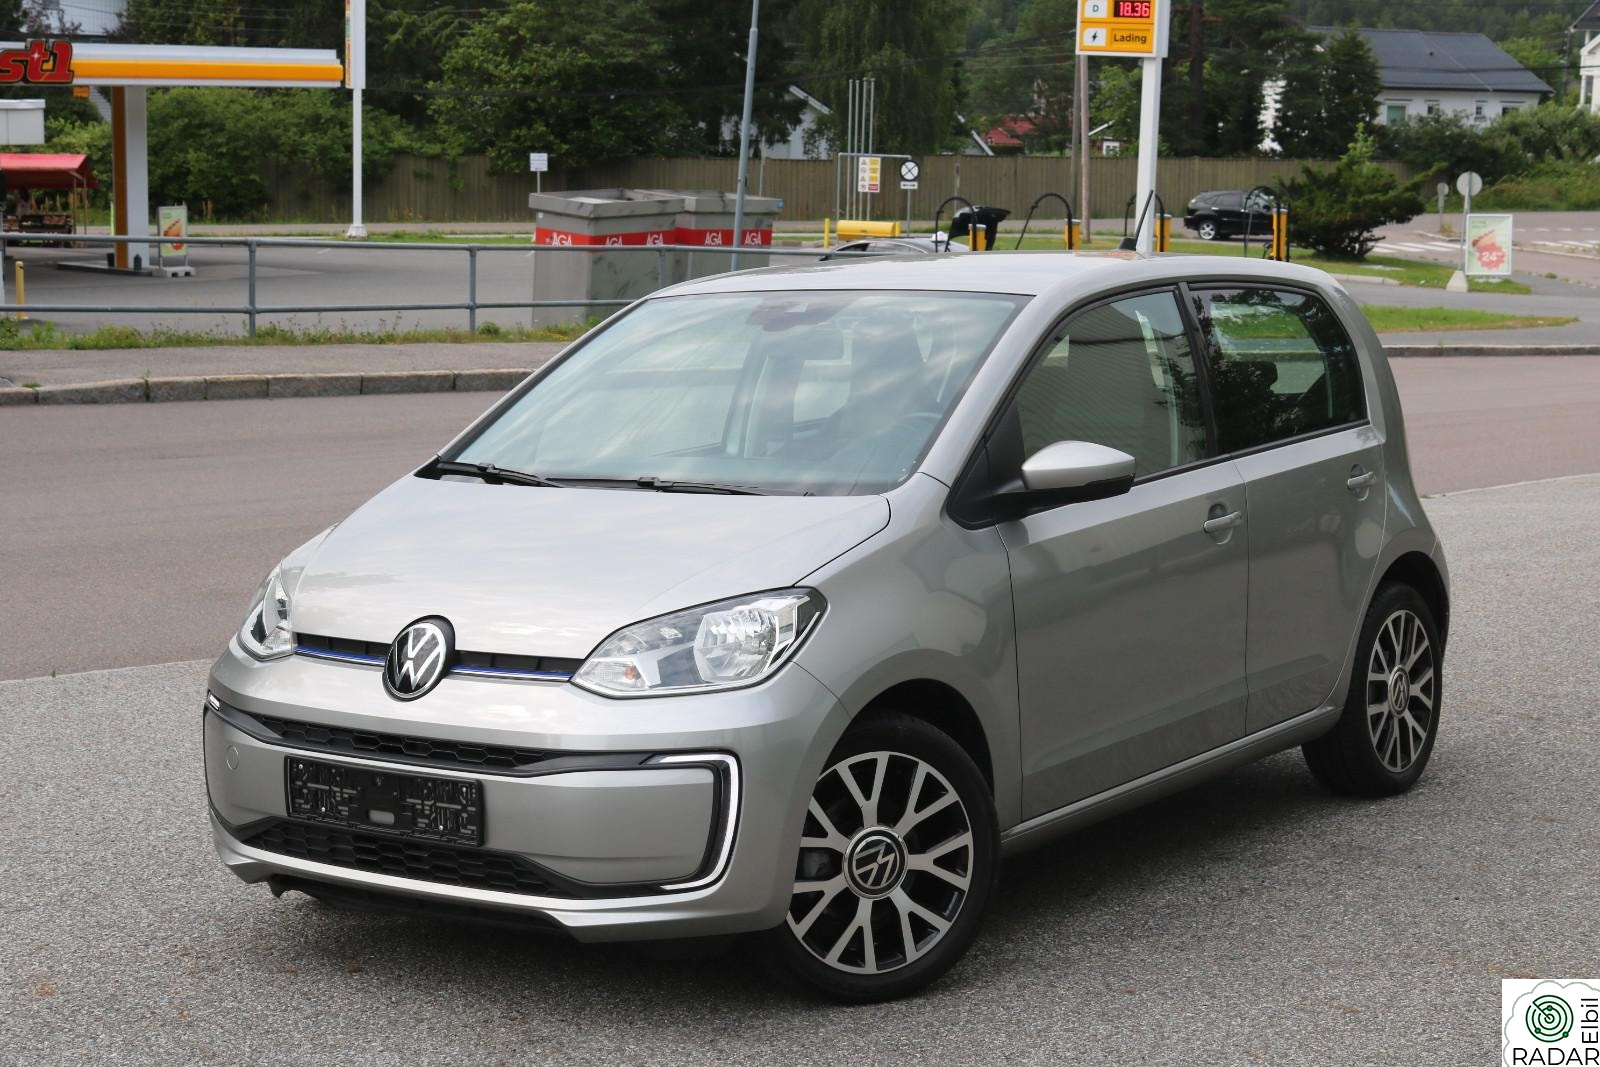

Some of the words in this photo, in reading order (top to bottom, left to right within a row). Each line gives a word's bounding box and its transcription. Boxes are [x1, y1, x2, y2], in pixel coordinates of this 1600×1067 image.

[1092, 4, 1100, 13] D
[1119, 2, 1150, 17] 18.36
[1113, 32, 1147, 44] Lading
[552, 231, 573, 246] AGA
[605, 235, 623, 246] AGA
[646, 232, 664, 247] AGA
[704, 231, 722, 246] AGA
[744, 231, 762, 246] AGA
